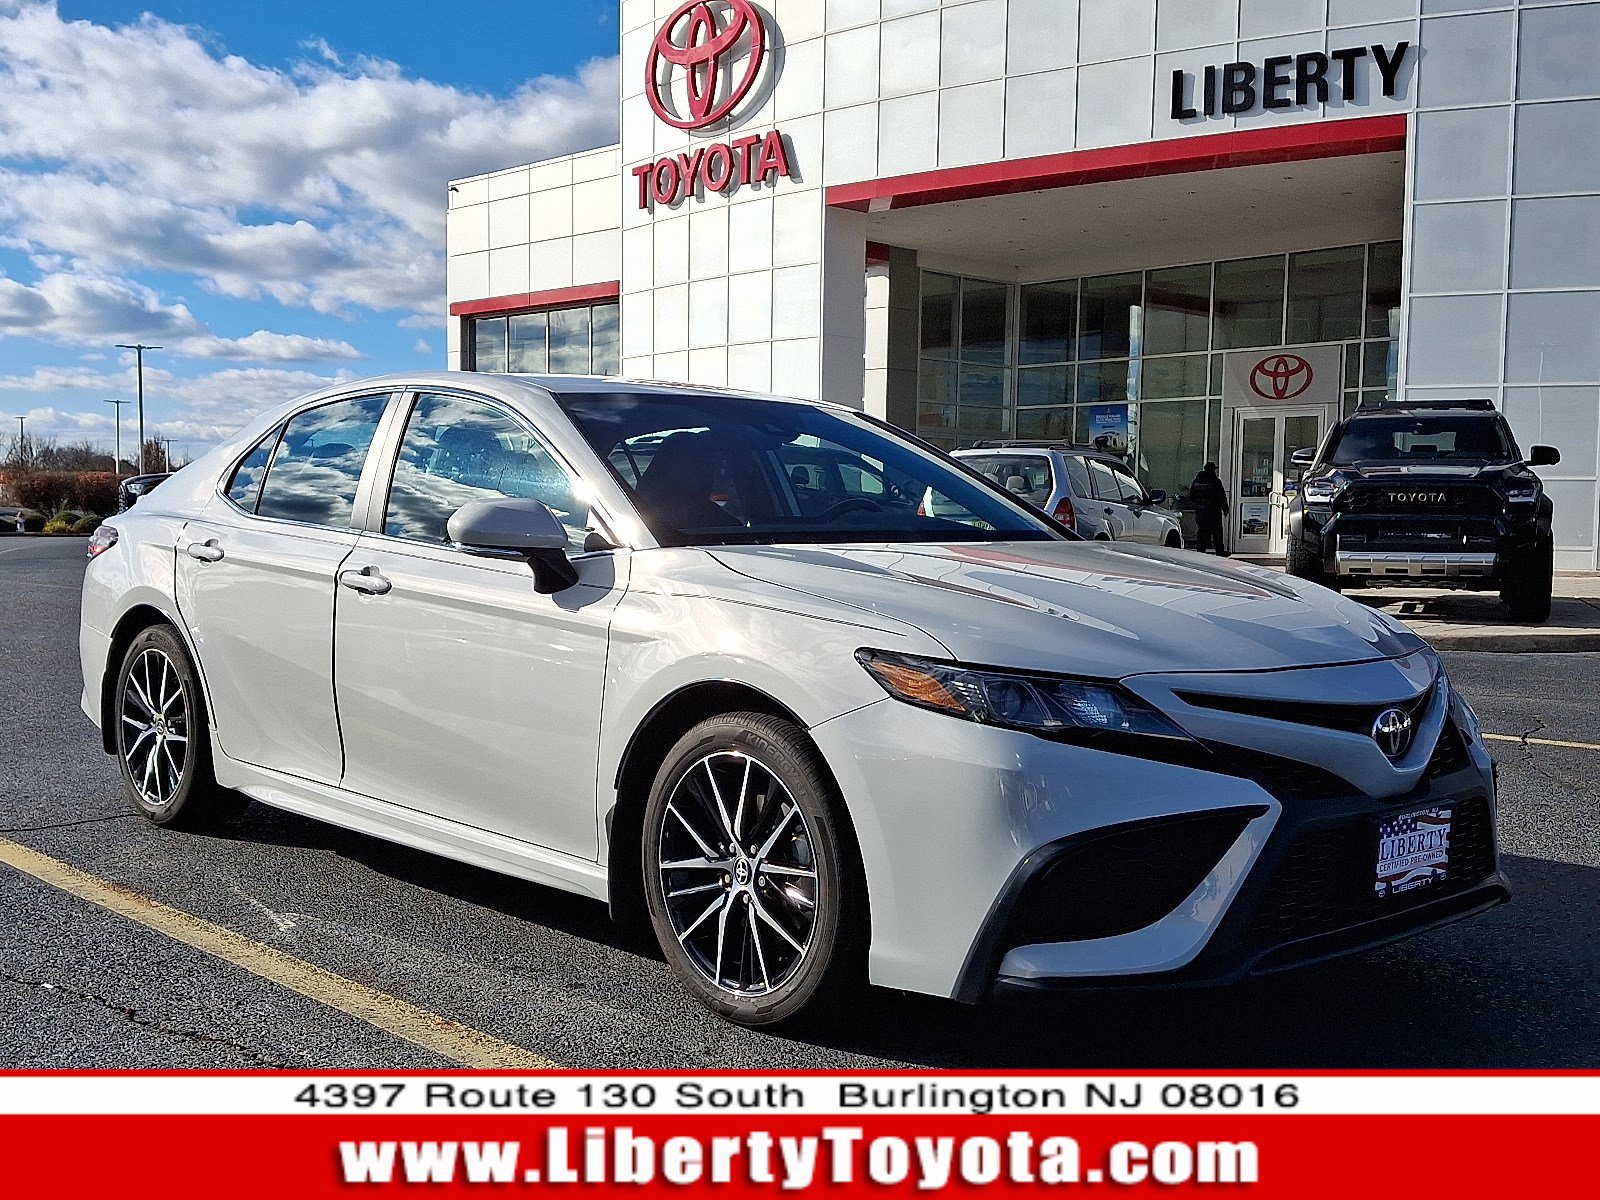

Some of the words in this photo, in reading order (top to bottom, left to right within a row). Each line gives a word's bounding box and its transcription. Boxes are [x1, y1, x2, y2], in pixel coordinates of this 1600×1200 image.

[1171, 41, 1409, 119] LIBERTY
[632, 129, 791, 209] TOYOTA
[1388, 492, 1446, 502] TOYOTA
[1380, 827, 1446, 860] LIBERTY
[1379, 857, 1410, 872] CERTIFIED
[1410, 849, 1444, 864] PRE-OWNED
[1392, 877, 1434, 894] LIBERTY
